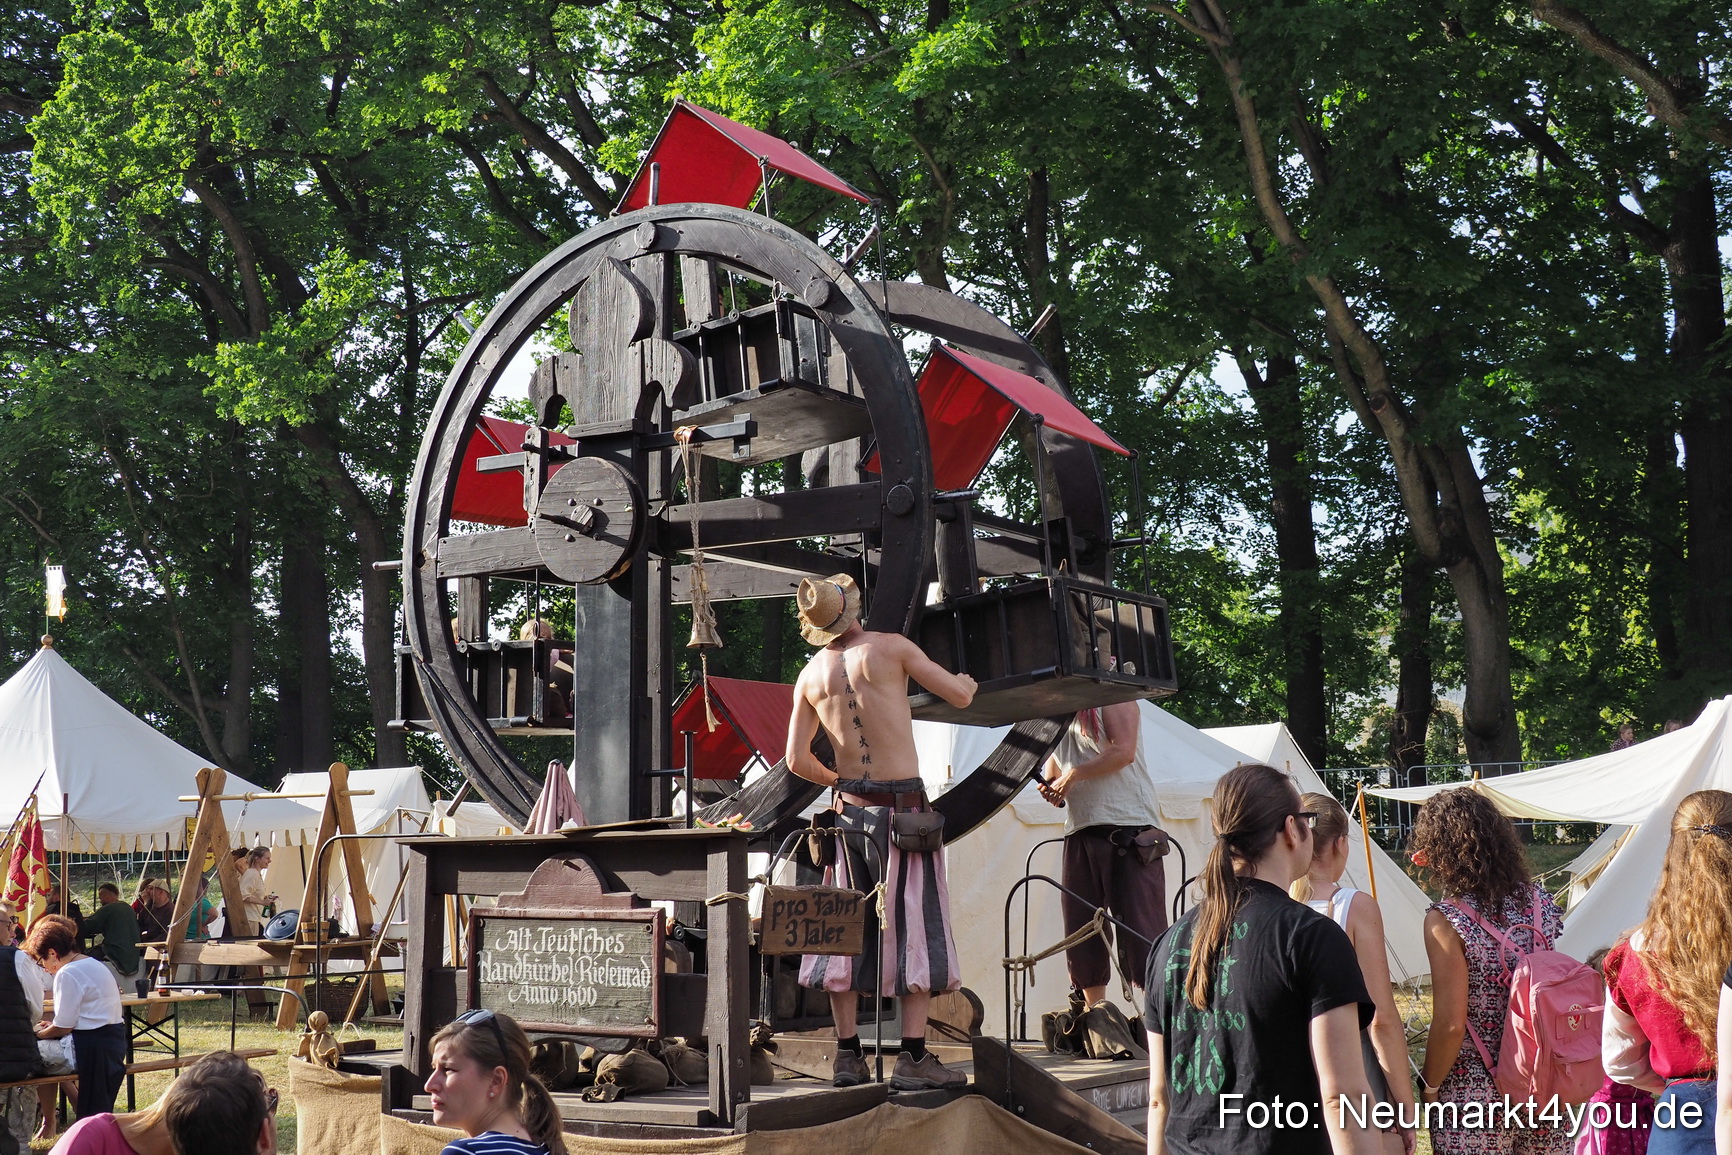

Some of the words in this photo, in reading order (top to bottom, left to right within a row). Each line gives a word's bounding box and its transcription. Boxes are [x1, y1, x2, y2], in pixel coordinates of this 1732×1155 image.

[771, 898, 808, 931] pro
[812, 891, 862, 917] Fahrt
[495, 927, 532, 953] Alt
[785, 918, 798, 947] 3
[799, 918, 845, 948] Taler
[508, 981, 559, 1005] Anno
[560, 984, 598, 1008] 1600
[1171, 1034, 1225, 1095] old
